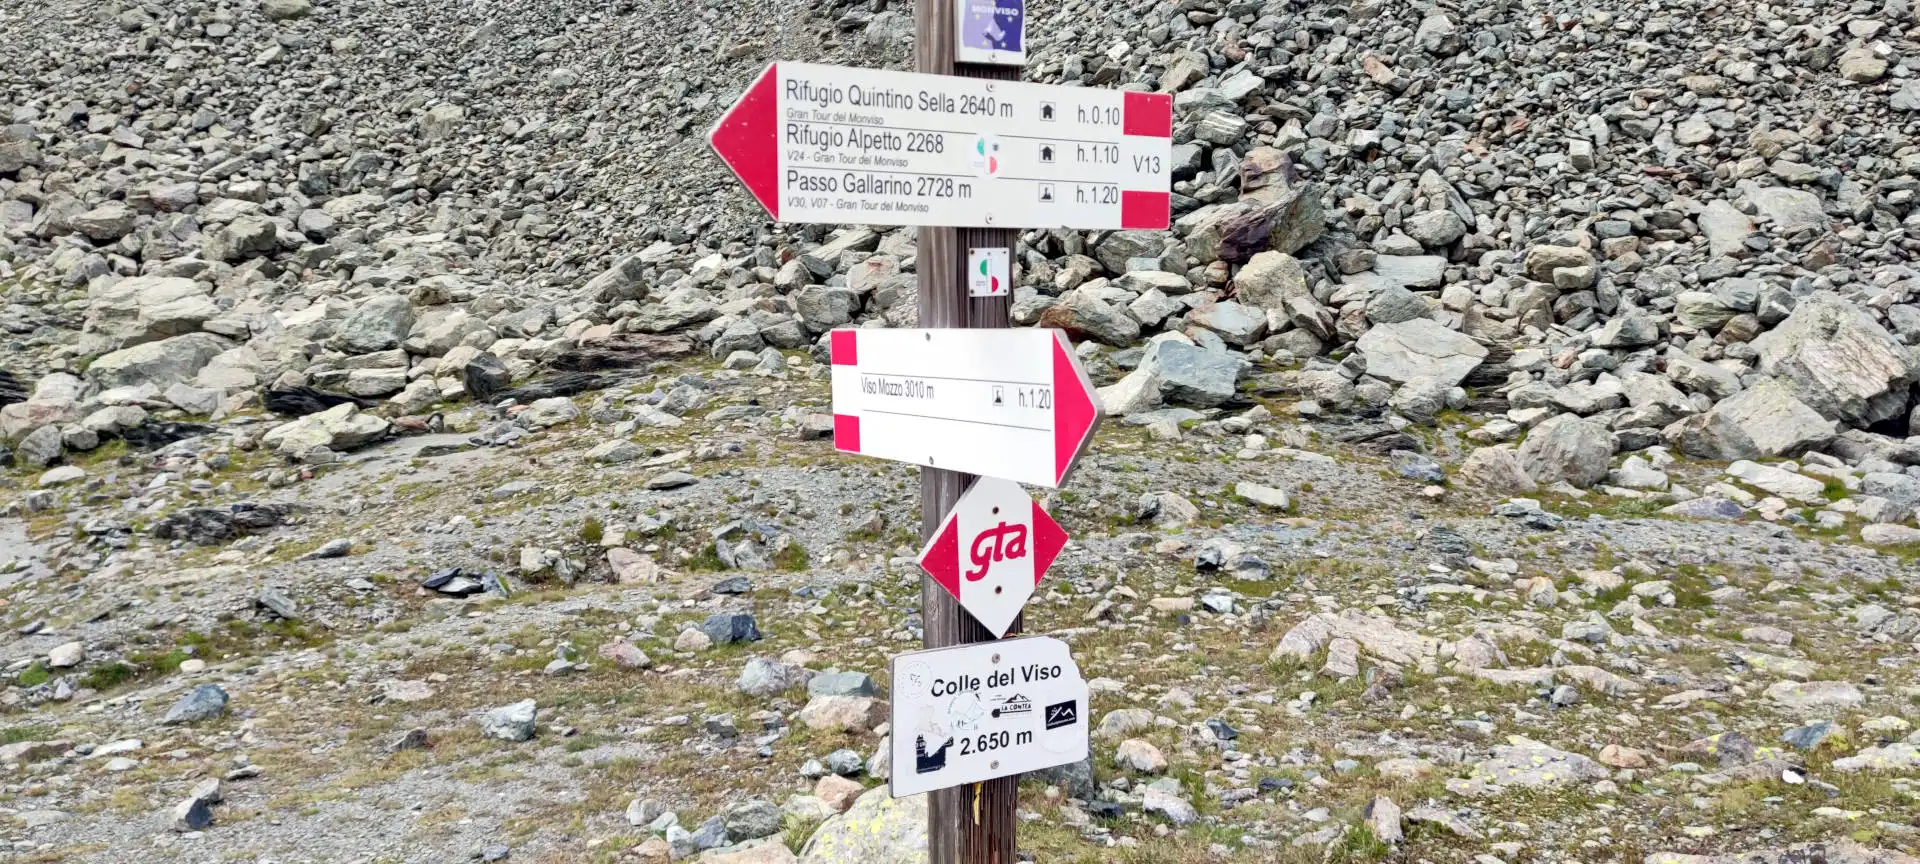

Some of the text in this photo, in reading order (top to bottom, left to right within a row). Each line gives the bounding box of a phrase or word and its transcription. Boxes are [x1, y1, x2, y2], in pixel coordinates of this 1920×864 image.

[786, 79, 1013, 118] Rifugio Quintino Sella 2640 m
[786, 107, 885, 125] Gran Tour del Monviso
[786, 123, 944, 154] Rifugio Alpetto 2268
[787, 150, 805, 161] V24
[813, 151, 835, 163] Gran
[838, 153, 857, 164] Tour
[858, 155, 872, 165] del
[873, 156, 909, 168] Monviso
[1133, 155, 1161, 174] V13
[787, 170, 972, 198] Passo Gallarino 2728 m
[787, 196, 807, 208] V30,
[811, 198, 828, 209] V07
[836, 198, 857, 210] Gran
[861, 200, 878, 210] Tour
[880, 202, 893, 212] del
[895, 202, 929, 213] Monviso
[861, 376, 935, 400] Viso Mozzo 3010 m
[965, 521, 1027, 582] gta
[931, 664, 1061, 697] Colle del Viso
[960, 731, 1032, 756] 2.650 m
